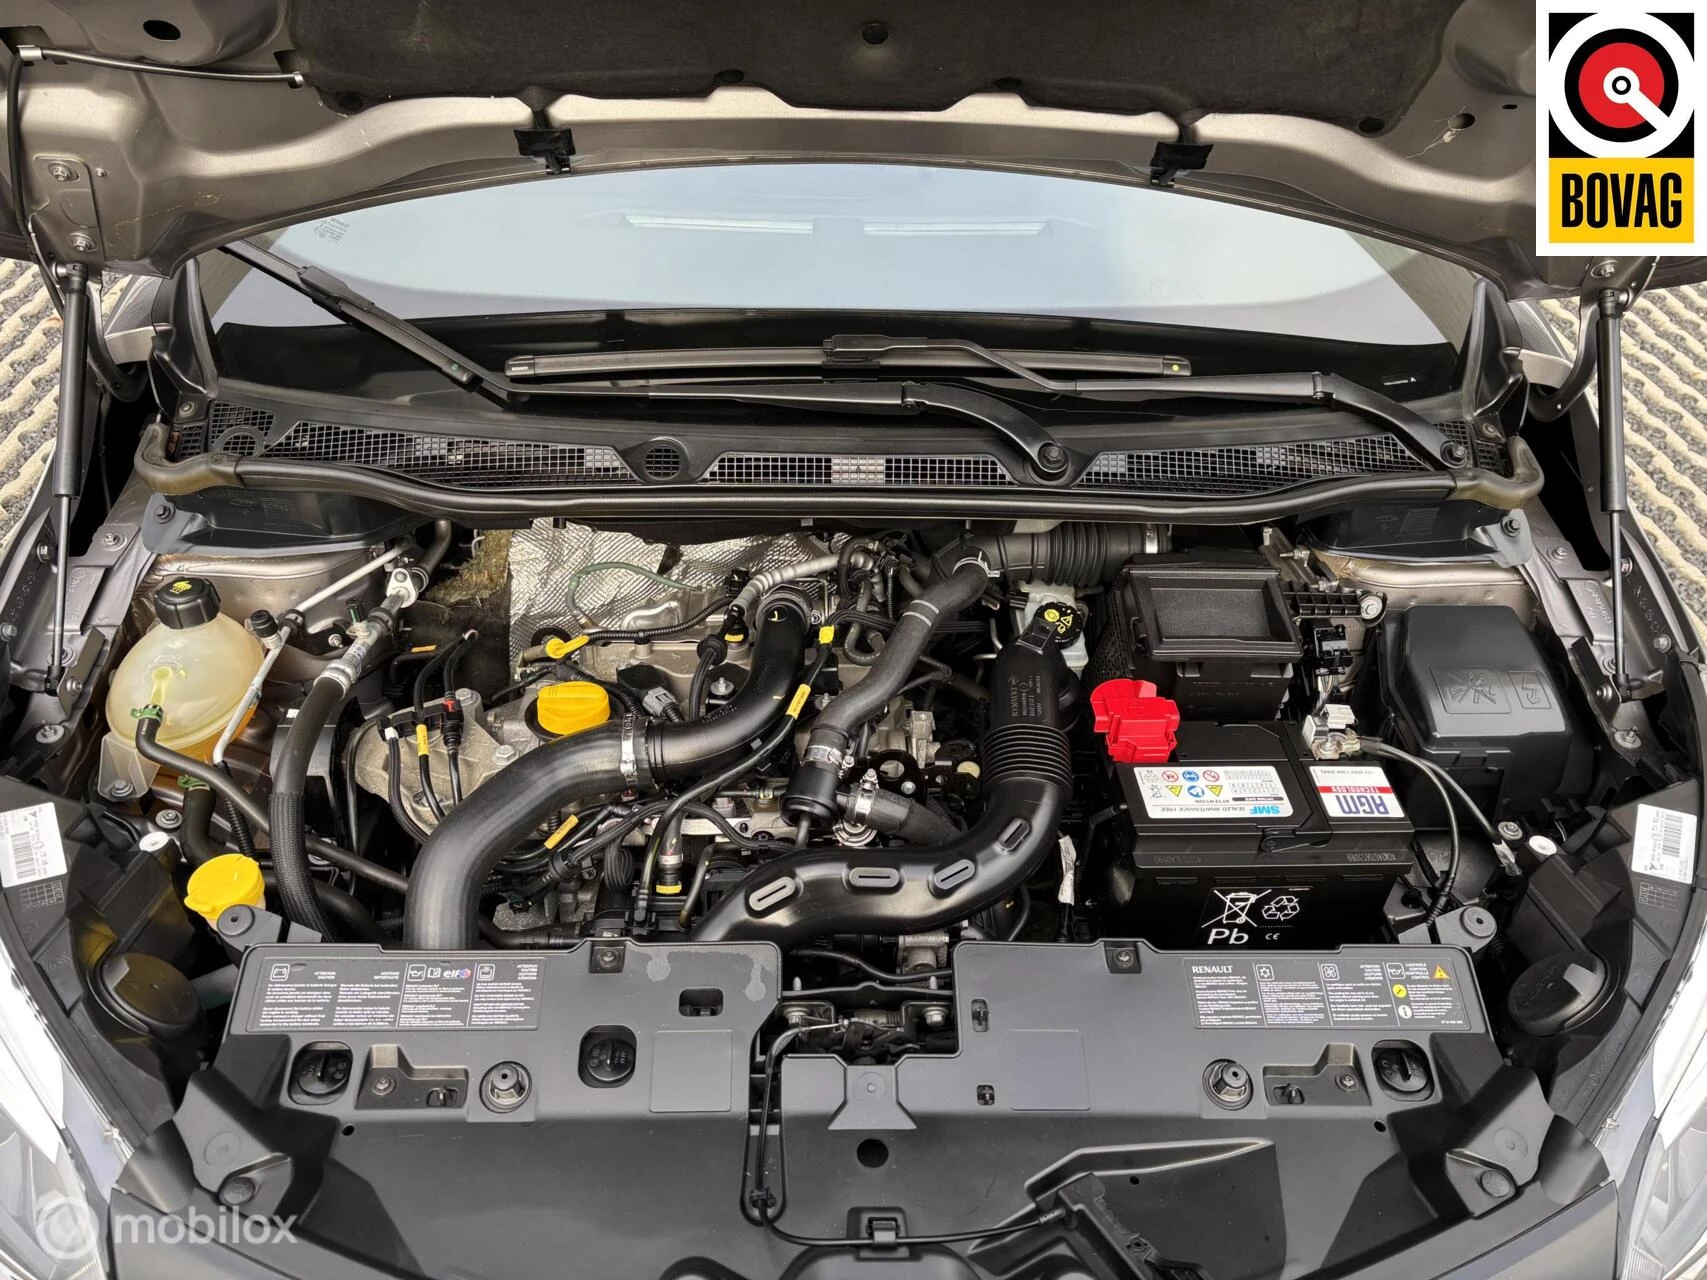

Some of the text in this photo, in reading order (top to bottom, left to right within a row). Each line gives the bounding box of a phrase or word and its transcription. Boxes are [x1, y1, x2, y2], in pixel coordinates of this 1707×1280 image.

[1335, 794, 1390, 815] AGM
[1249, 805, 1281, 815] SMF
[1207, 928, 1249, 945] Pb
[443, 969, 461, 978] elf
[1191, 965, 1233, 974] RENAULT
